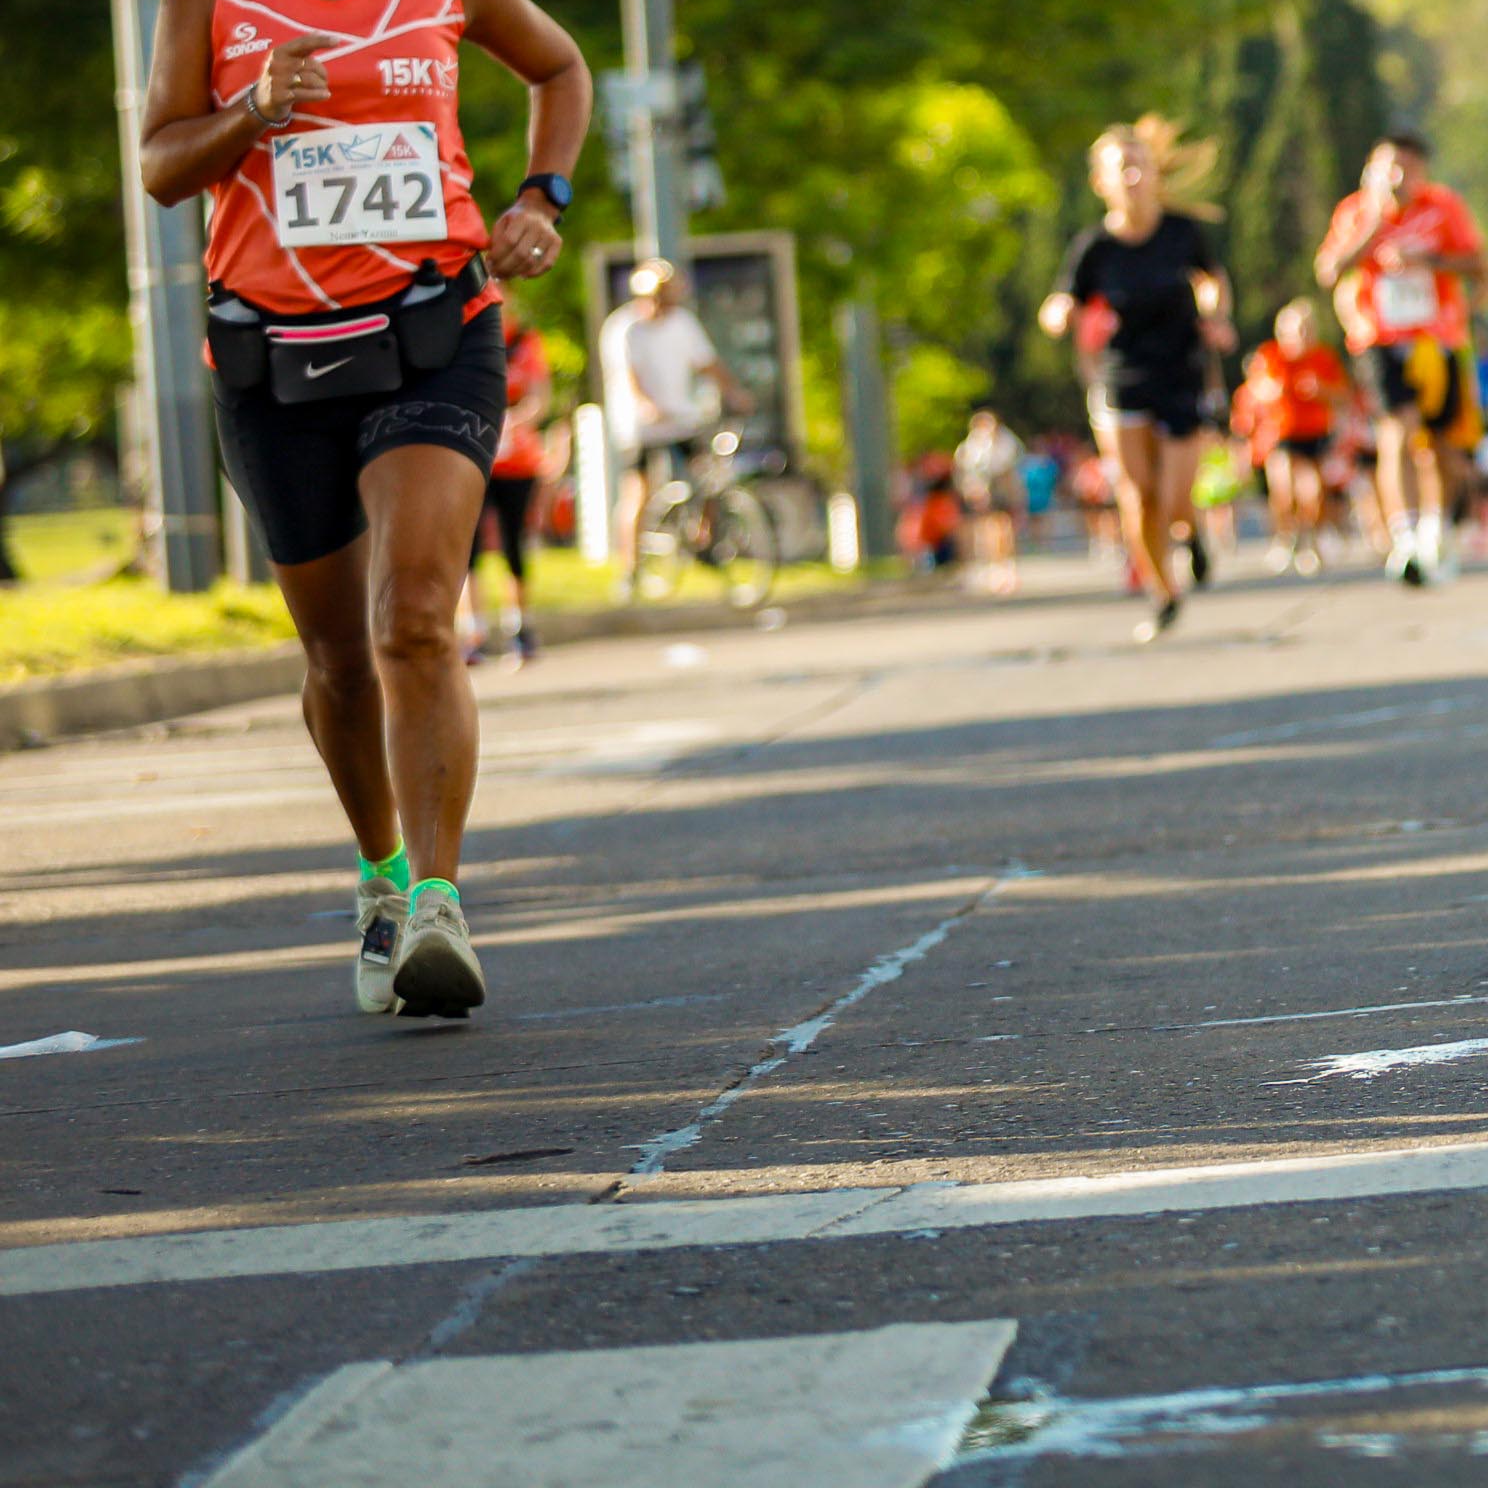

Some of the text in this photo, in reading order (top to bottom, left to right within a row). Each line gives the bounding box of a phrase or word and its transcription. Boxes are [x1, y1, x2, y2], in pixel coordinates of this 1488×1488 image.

[378, 58, 433, 86] 15K
[290, 144, 334, 169] 15K
[285, 171, 437, 229] 1742
